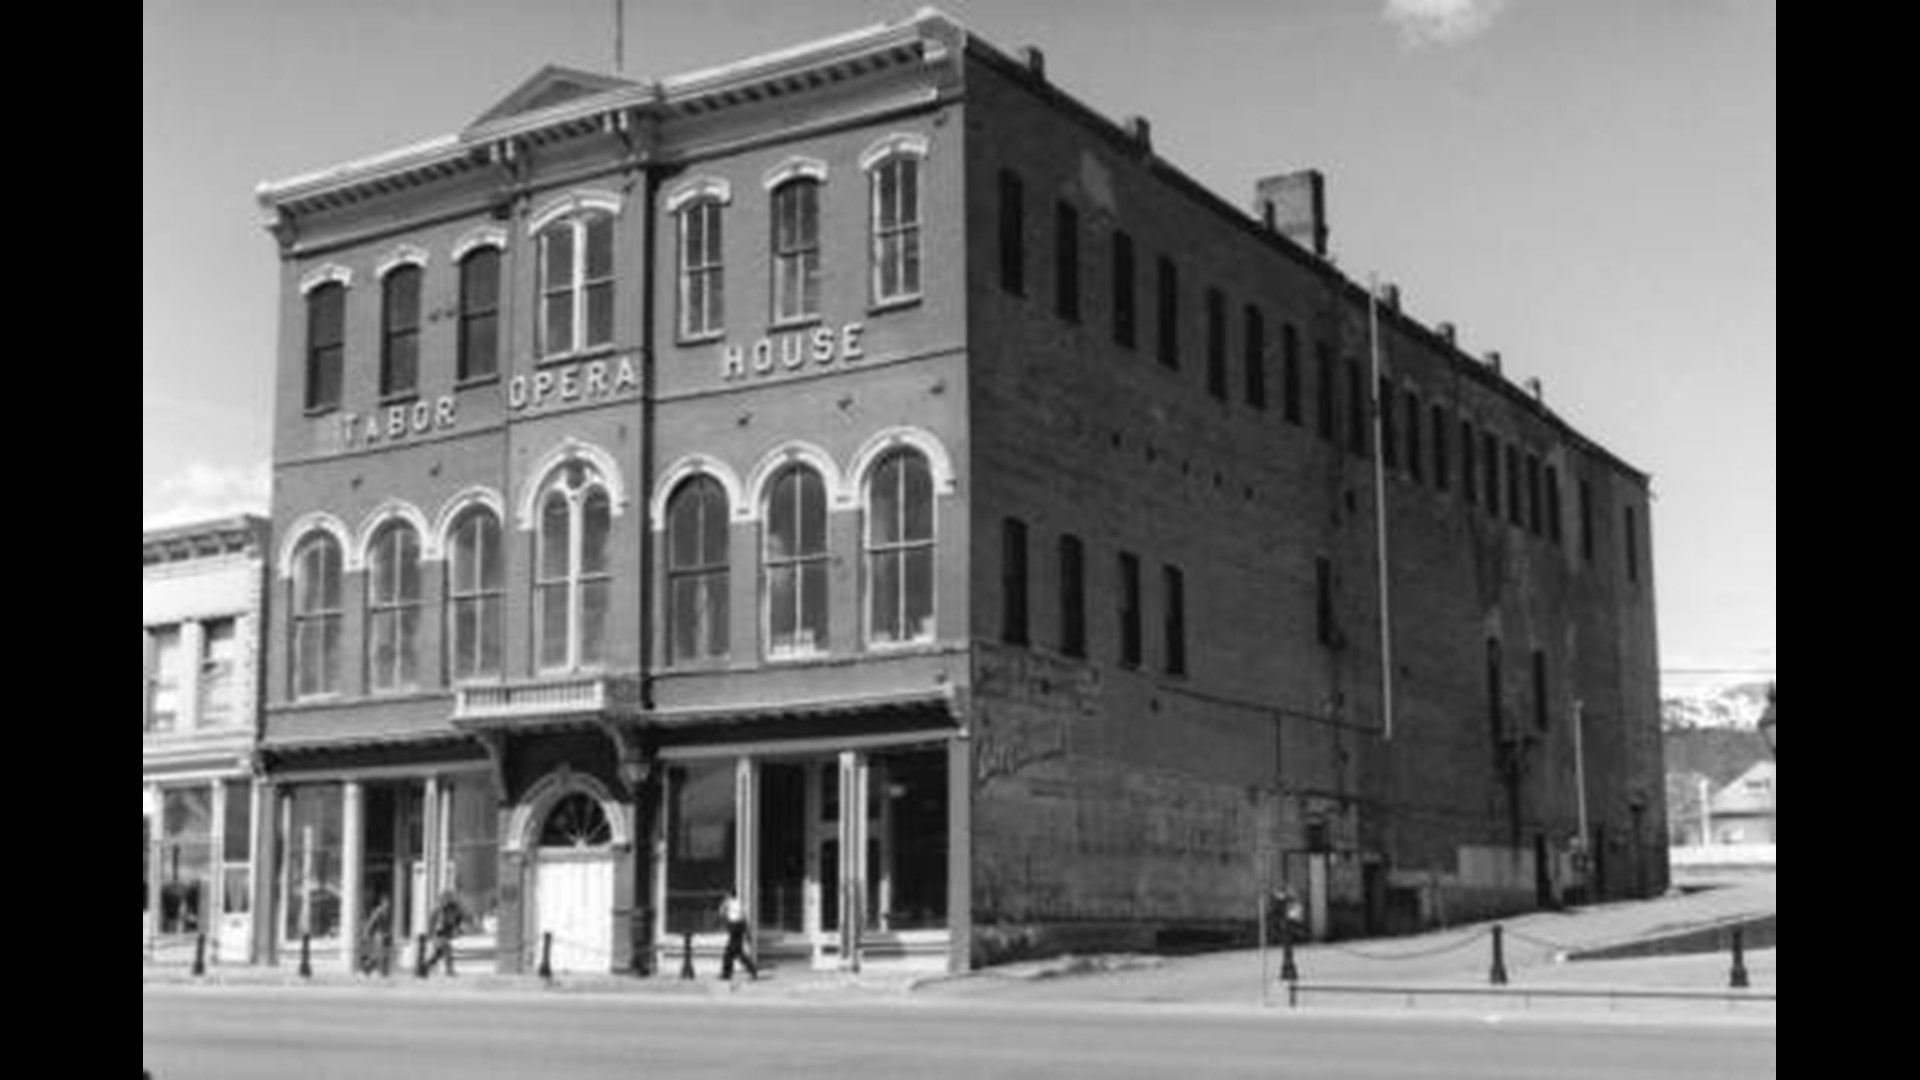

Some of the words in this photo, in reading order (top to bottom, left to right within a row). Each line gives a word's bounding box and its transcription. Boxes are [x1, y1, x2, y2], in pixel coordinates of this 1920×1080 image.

[340, 397, 456, 444] TABOR
[508, 357, 638, 408] OPERA
[721, 323, 865, 378] HOUSE
